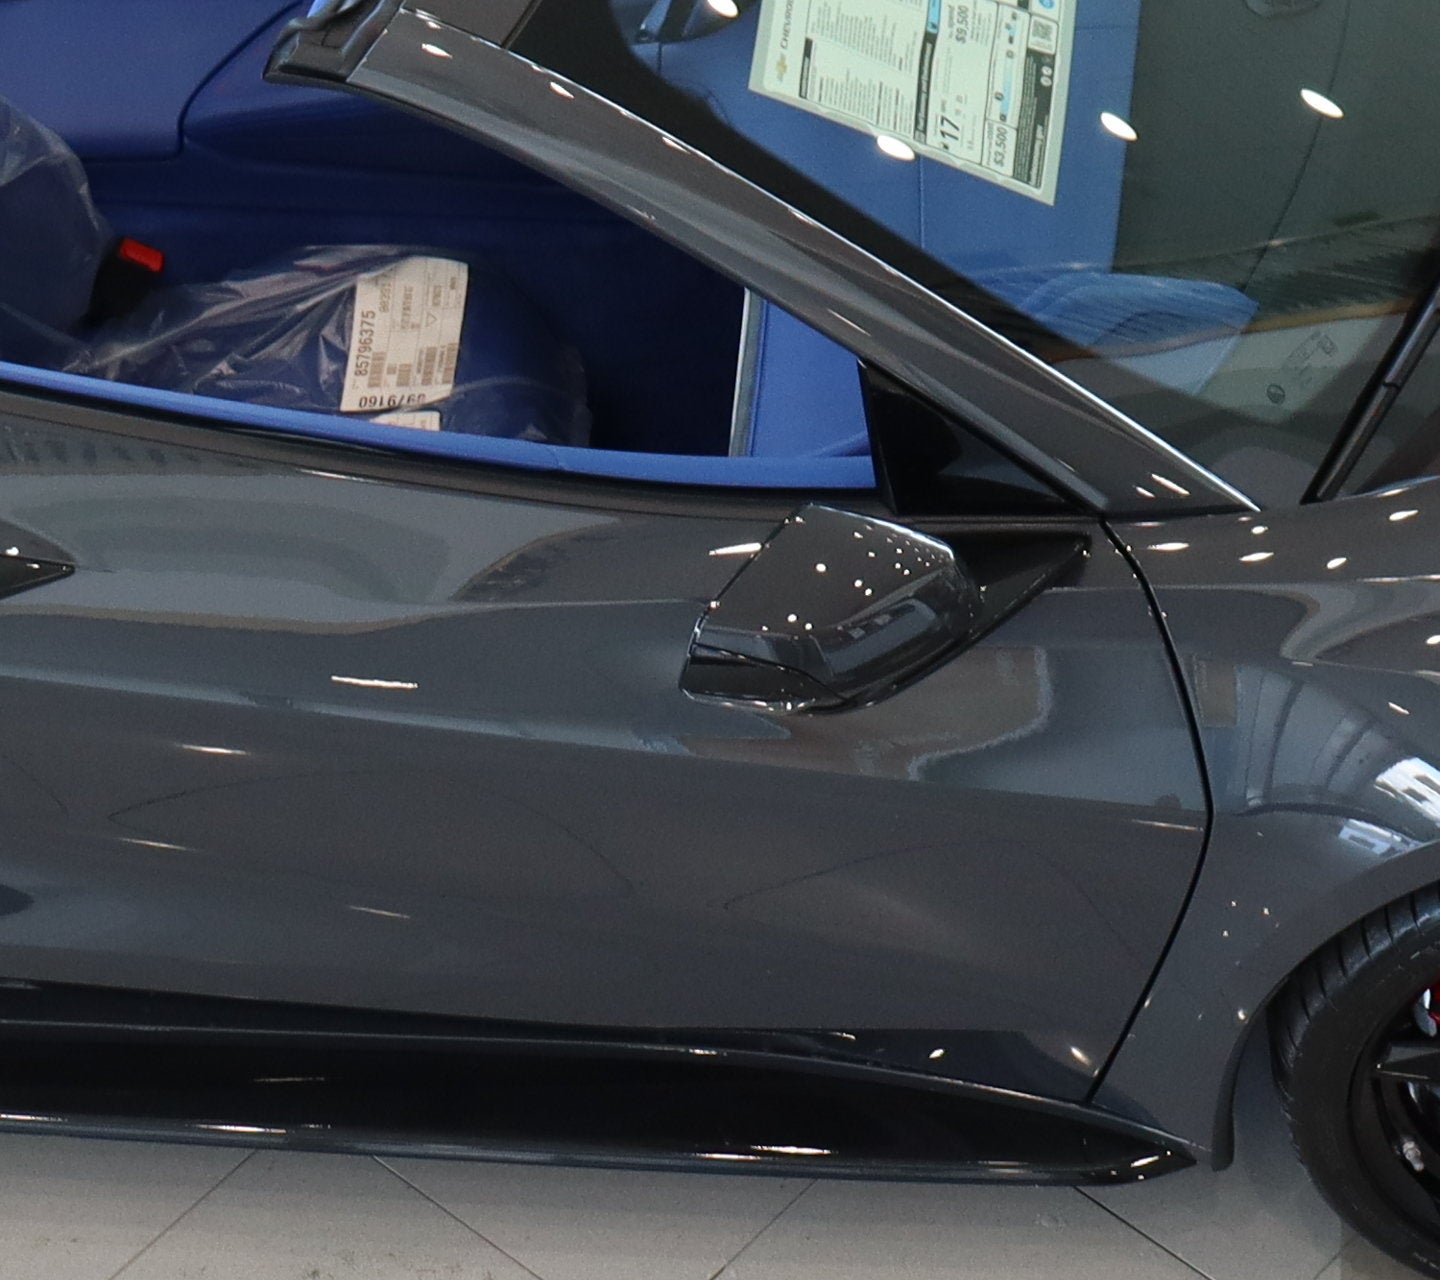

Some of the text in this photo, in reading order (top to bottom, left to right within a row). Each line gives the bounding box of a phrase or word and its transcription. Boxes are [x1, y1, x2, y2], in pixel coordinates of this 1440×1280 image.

[955, 5, 969, 44] $9,500
[940, 115, 960, 141] 17
[994, 126, 1007, 167] $3,500
[354, 310, 376, 376] 85796375
